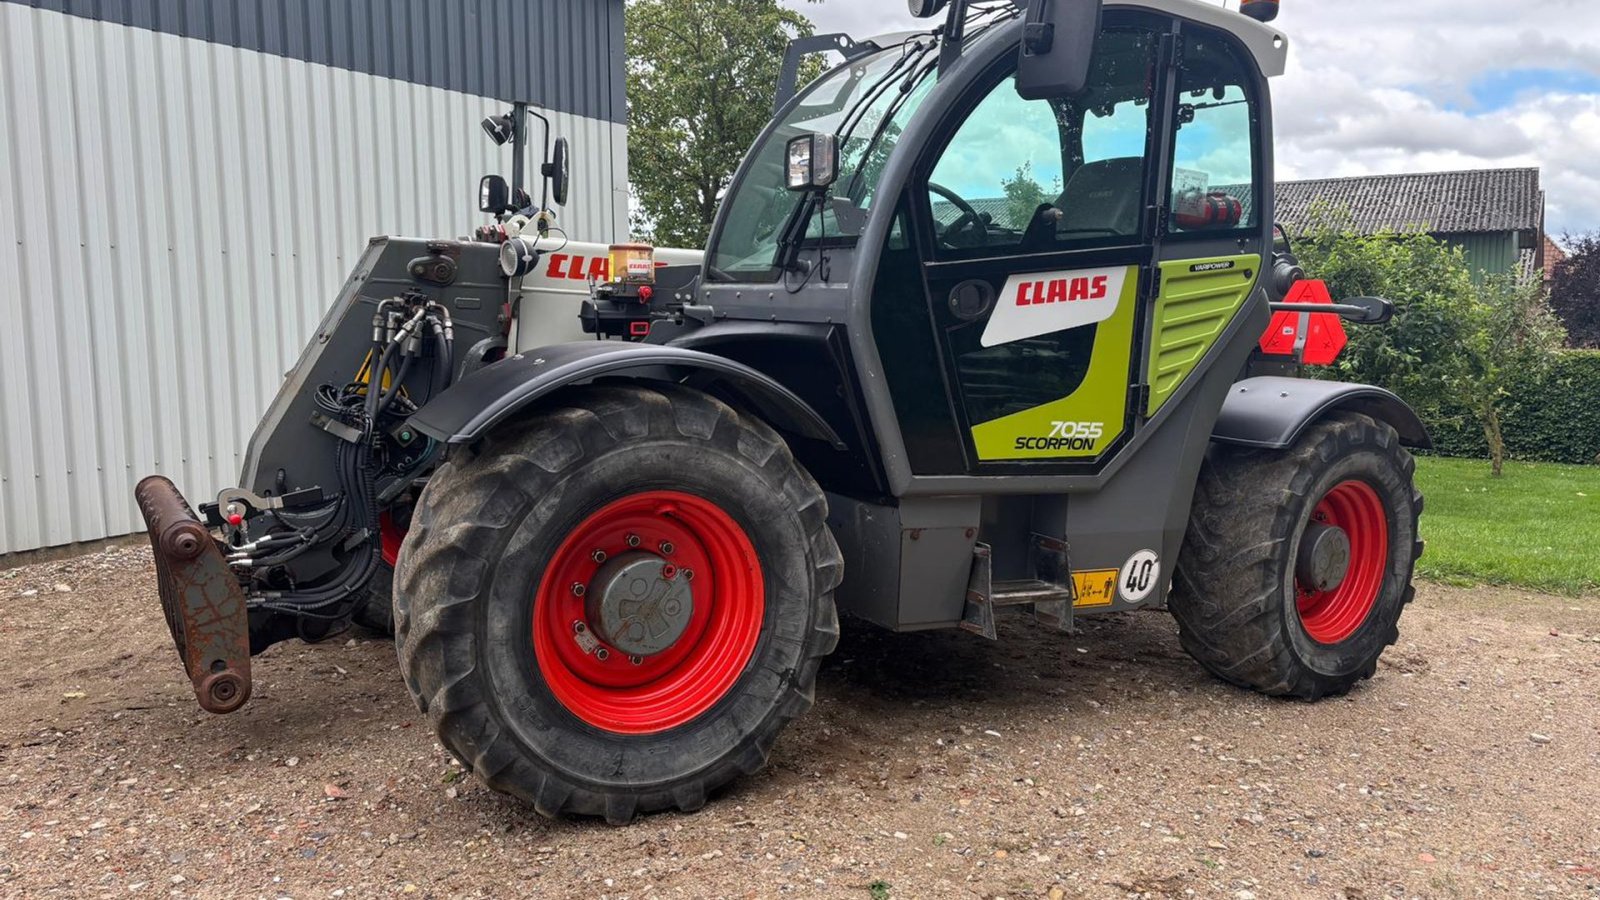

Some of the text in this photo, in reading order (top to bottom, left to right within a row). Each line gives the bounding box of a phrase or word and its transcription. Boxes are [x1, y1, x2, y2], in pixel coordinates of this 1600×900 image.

[1194, 262, 1230, 271] VARIPOWER
[1016, 276, 1107, 305] CLAAS
[1048, 421, 1104, 438] 7055
[1014, 436, 1095, 451] SCORPION
[1126, 560, 1152, 591] 40
